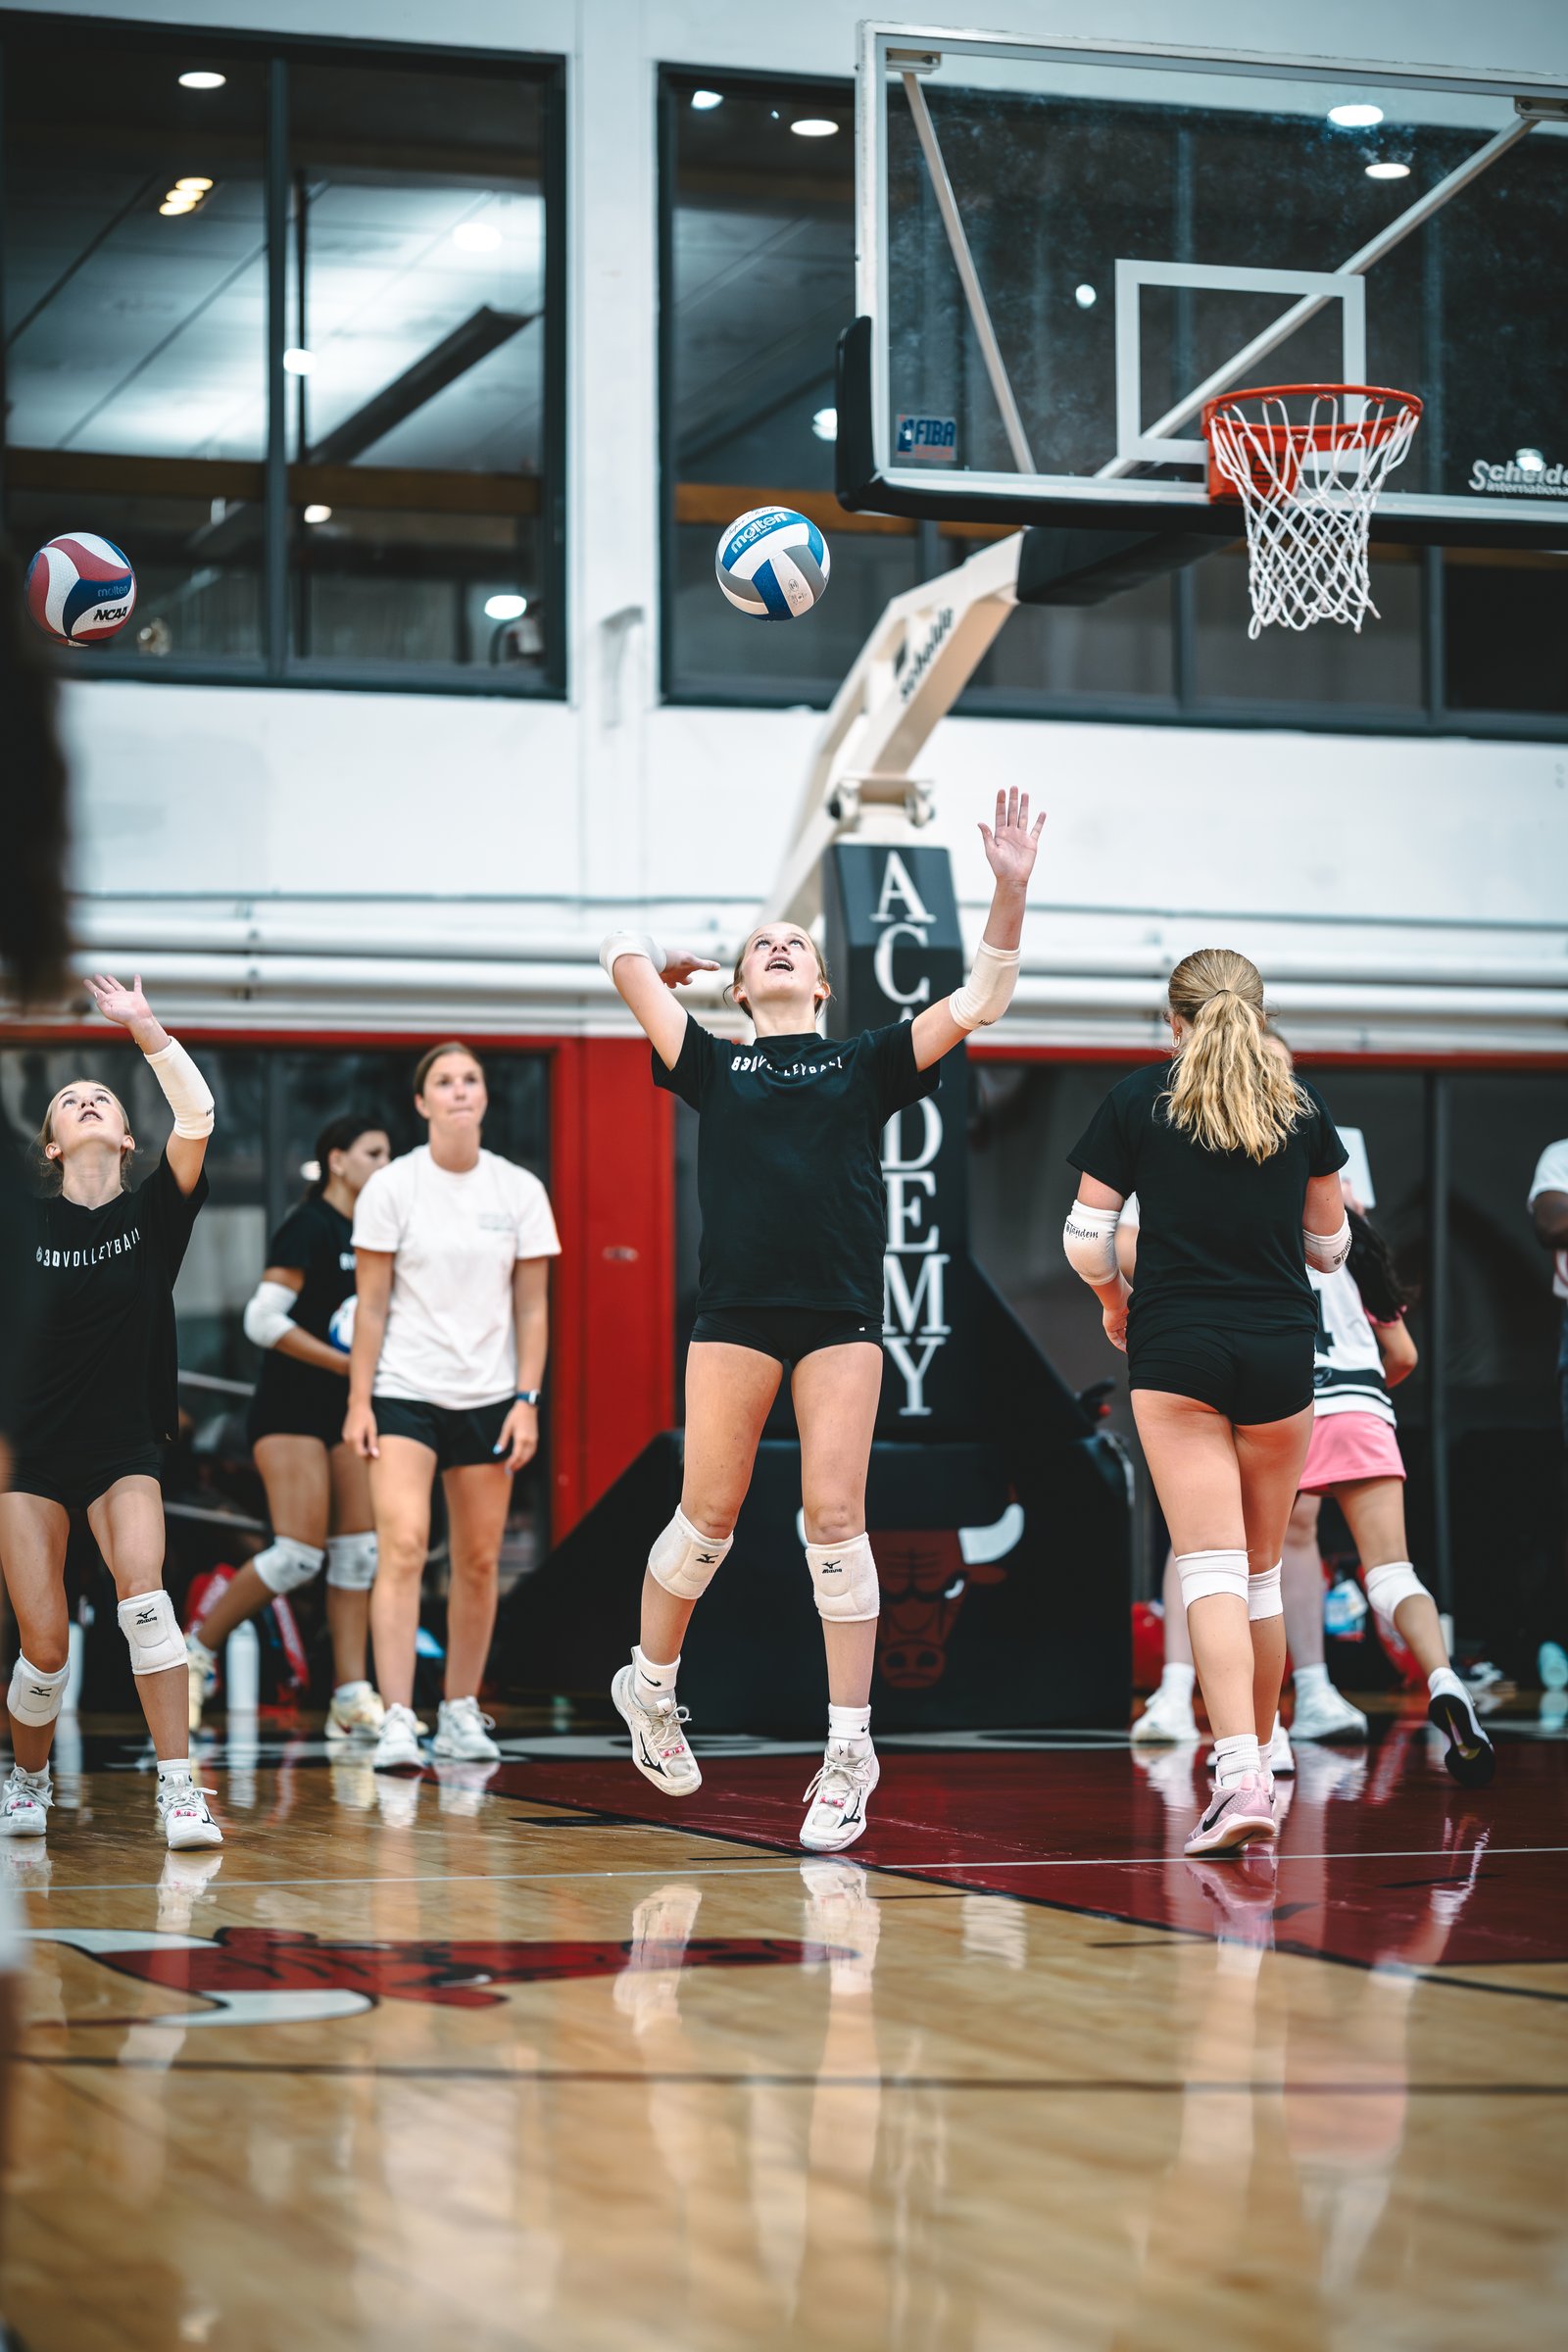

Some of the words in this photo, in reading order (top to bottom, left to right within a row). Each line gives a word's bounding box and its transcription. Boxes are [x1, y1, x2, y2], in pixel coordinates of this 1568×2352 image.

[914, 419, 956, 447] FIBA
[730, 512, 788, 555] molten
[97, 585, 128, 598] molten
[93, 606, 128, 621] NCAA
[868, 849, 952, 1416] ACDEMY
